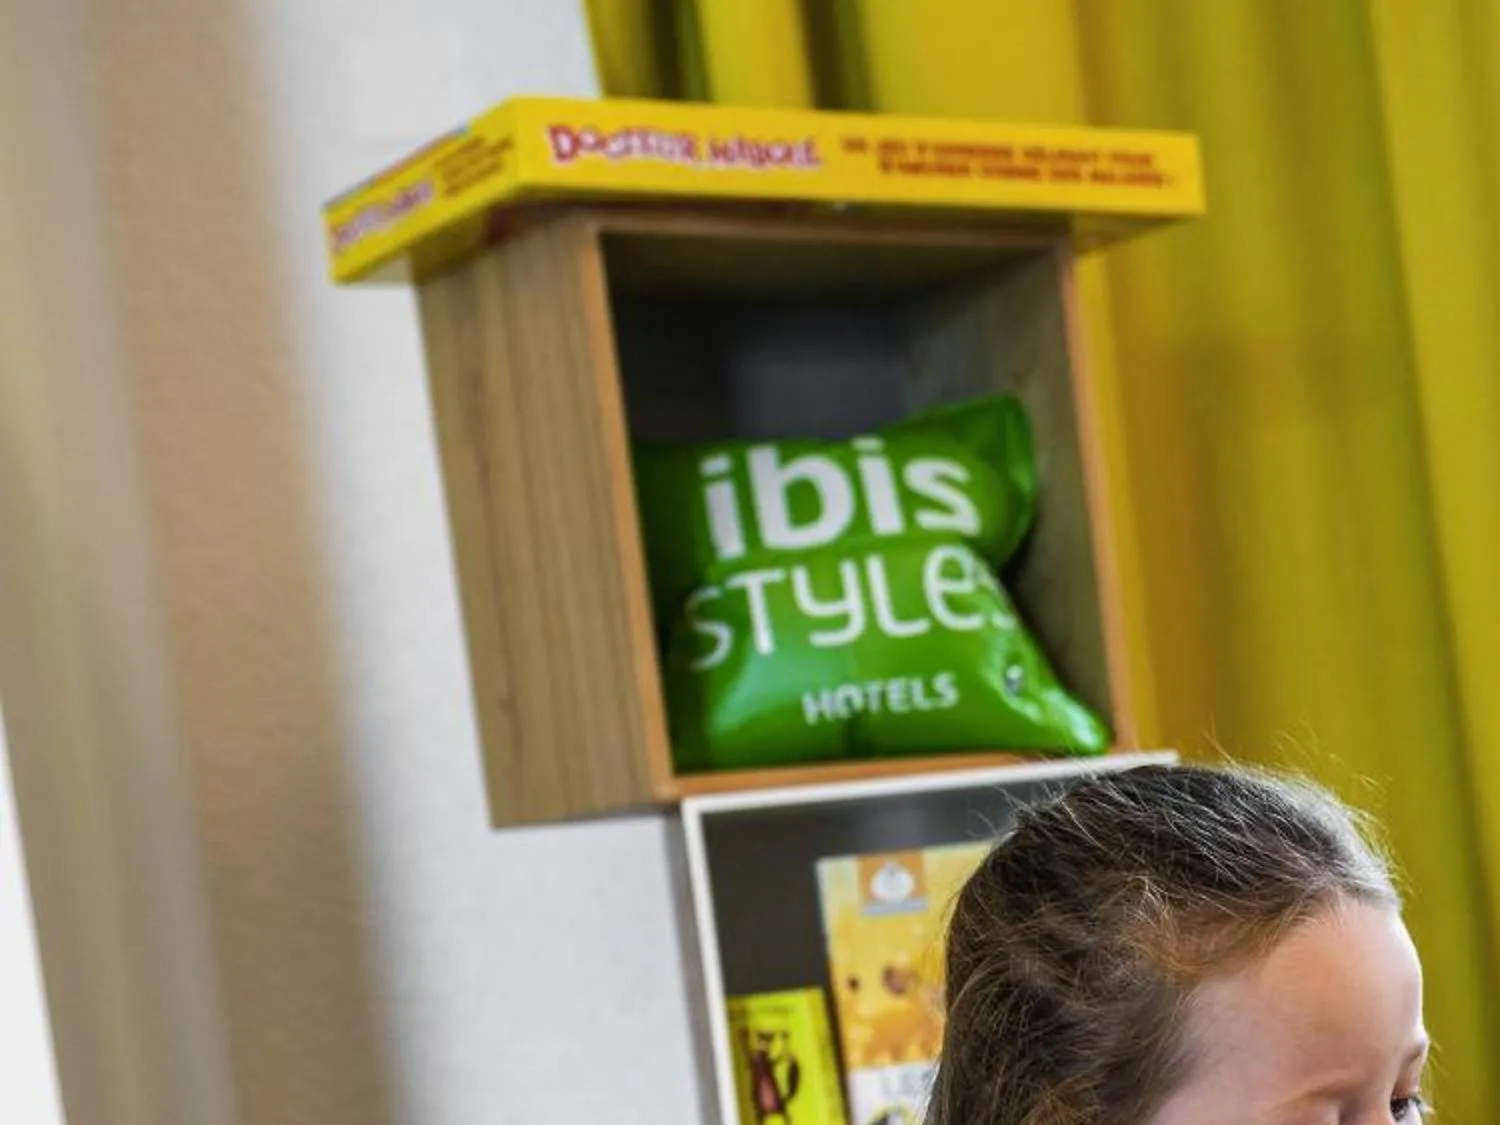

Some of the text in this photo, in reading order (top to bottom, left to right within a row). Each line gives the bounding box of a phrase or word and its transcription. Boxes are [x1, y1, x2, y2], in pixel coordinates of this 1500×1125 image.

[700, 436, 981, 561] ibis
[684, 542, 1016, 671] STYLE
[802, 671, 959, 726] HOTELS
